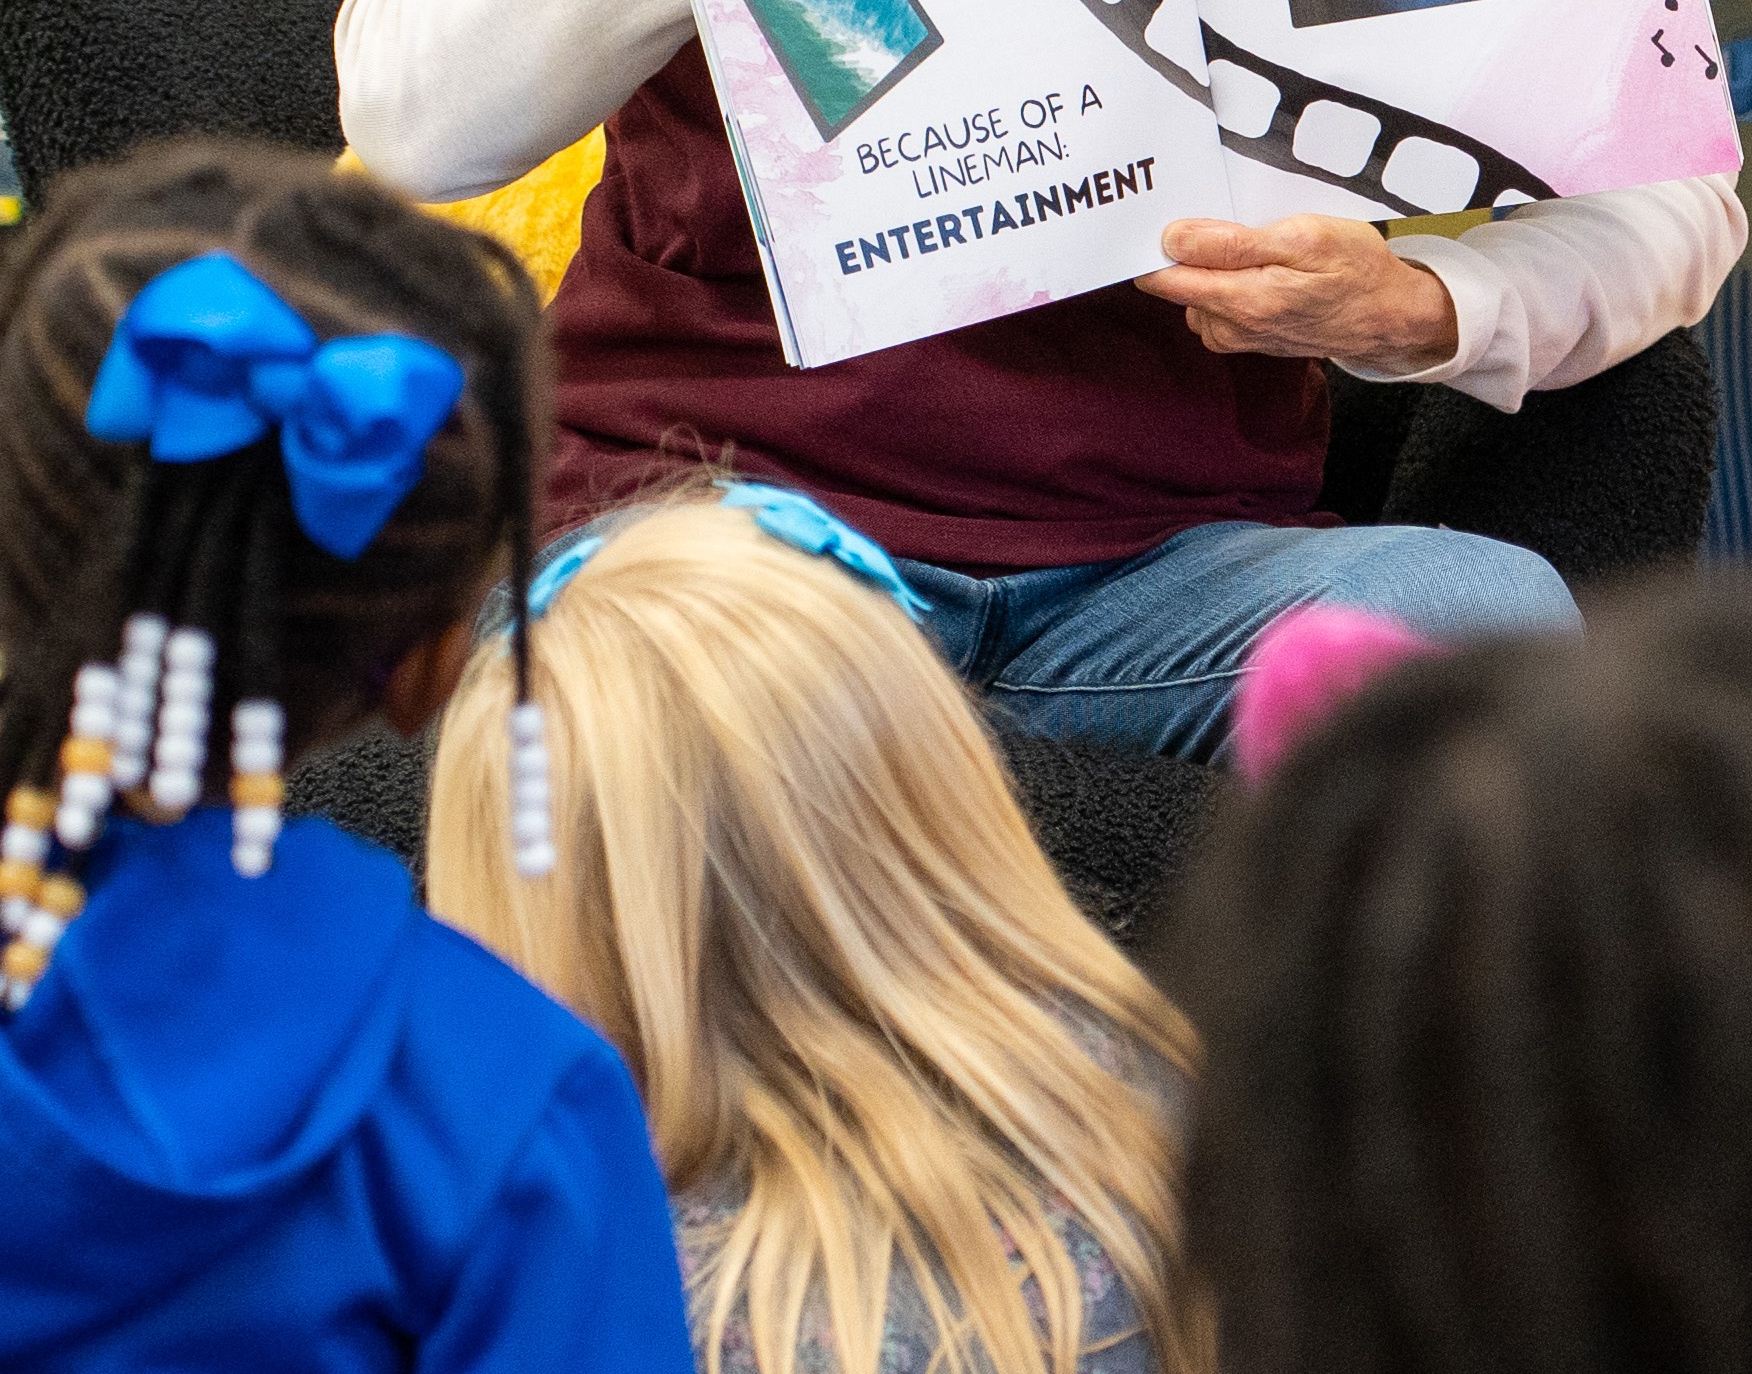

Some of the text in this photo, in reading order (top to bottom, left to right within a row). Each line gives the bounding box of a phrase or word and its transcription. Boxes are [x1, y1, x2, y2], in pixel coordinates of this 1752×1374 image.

[855, 82, 1103, 176] BECAUSE OF A
[911, 130, 1069, 199] LINEMAN:
[834, 156, 1156, 275] ENTERTAINMENT
